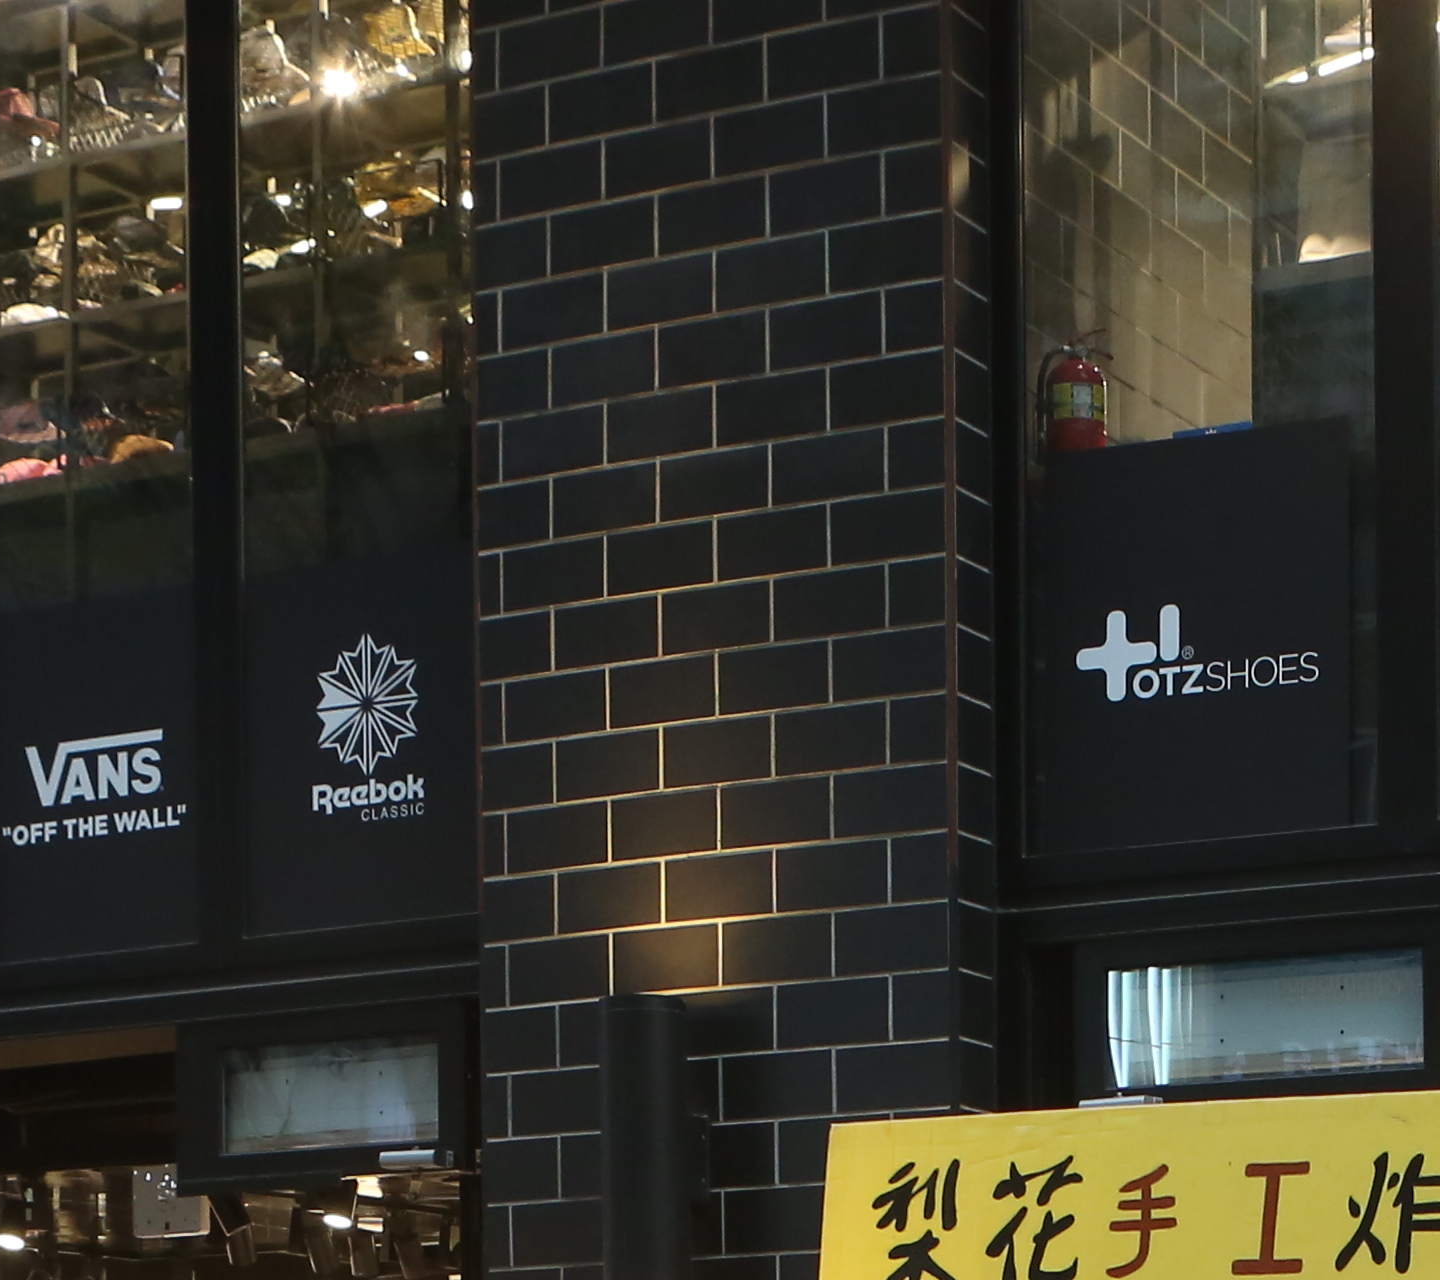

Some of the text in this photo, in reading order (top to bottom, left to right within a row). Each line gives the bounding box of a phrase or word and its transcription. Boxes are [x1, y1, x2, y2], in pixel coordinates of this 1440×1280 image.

[24, 728, 164, 807] VANS
[312, 773, 425, 815] Reebok
[62, 816, 109, 840] THE
[361, 803, 425, 823] CLASSIC
